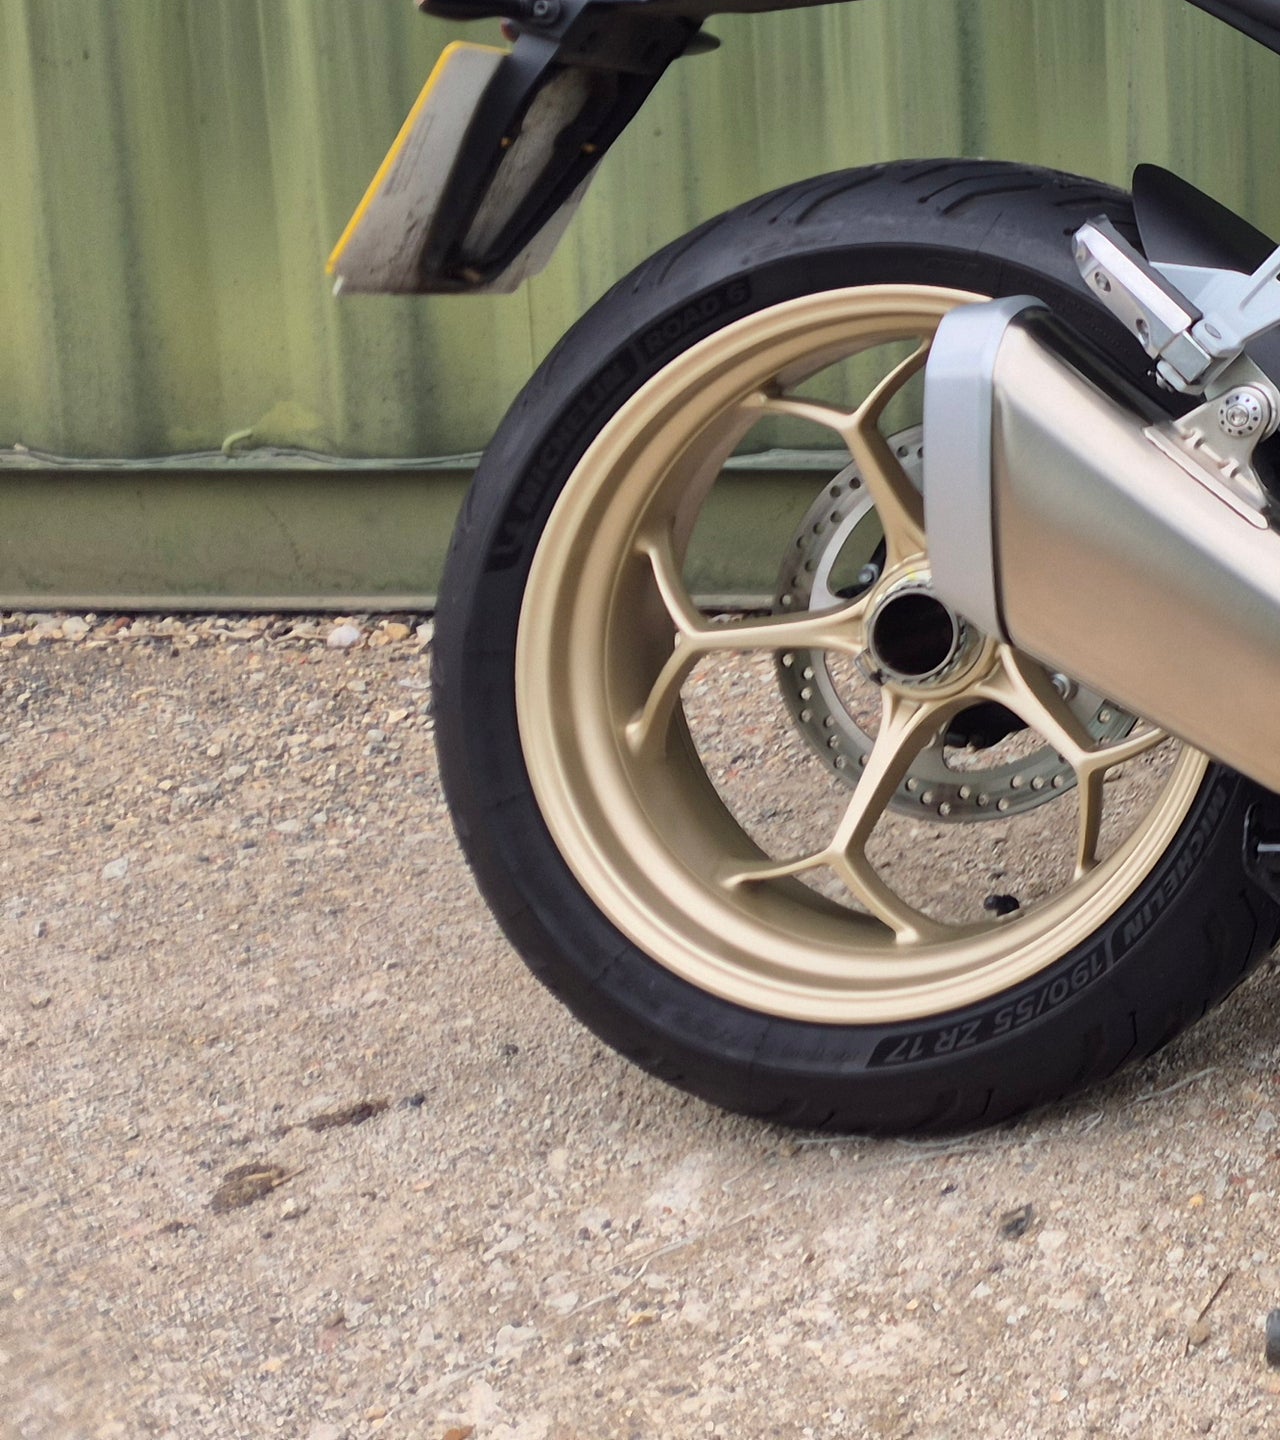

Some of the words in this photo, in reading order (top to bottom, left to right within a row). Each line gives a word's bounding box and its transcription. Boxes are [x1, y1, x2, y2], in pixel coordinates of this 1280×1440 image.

[512, 357, 630, 518] MICHELIN
[643, 295, 721, 357] ROAD
[725, 280, 747, 307] 6
[1122, 783, 1228, 946] MICHELIN
[993, 951, 1103, 1035] 190/55
[883, 1035, 924, 1063] 17
[933, 1018, 982, 1054] ZR
